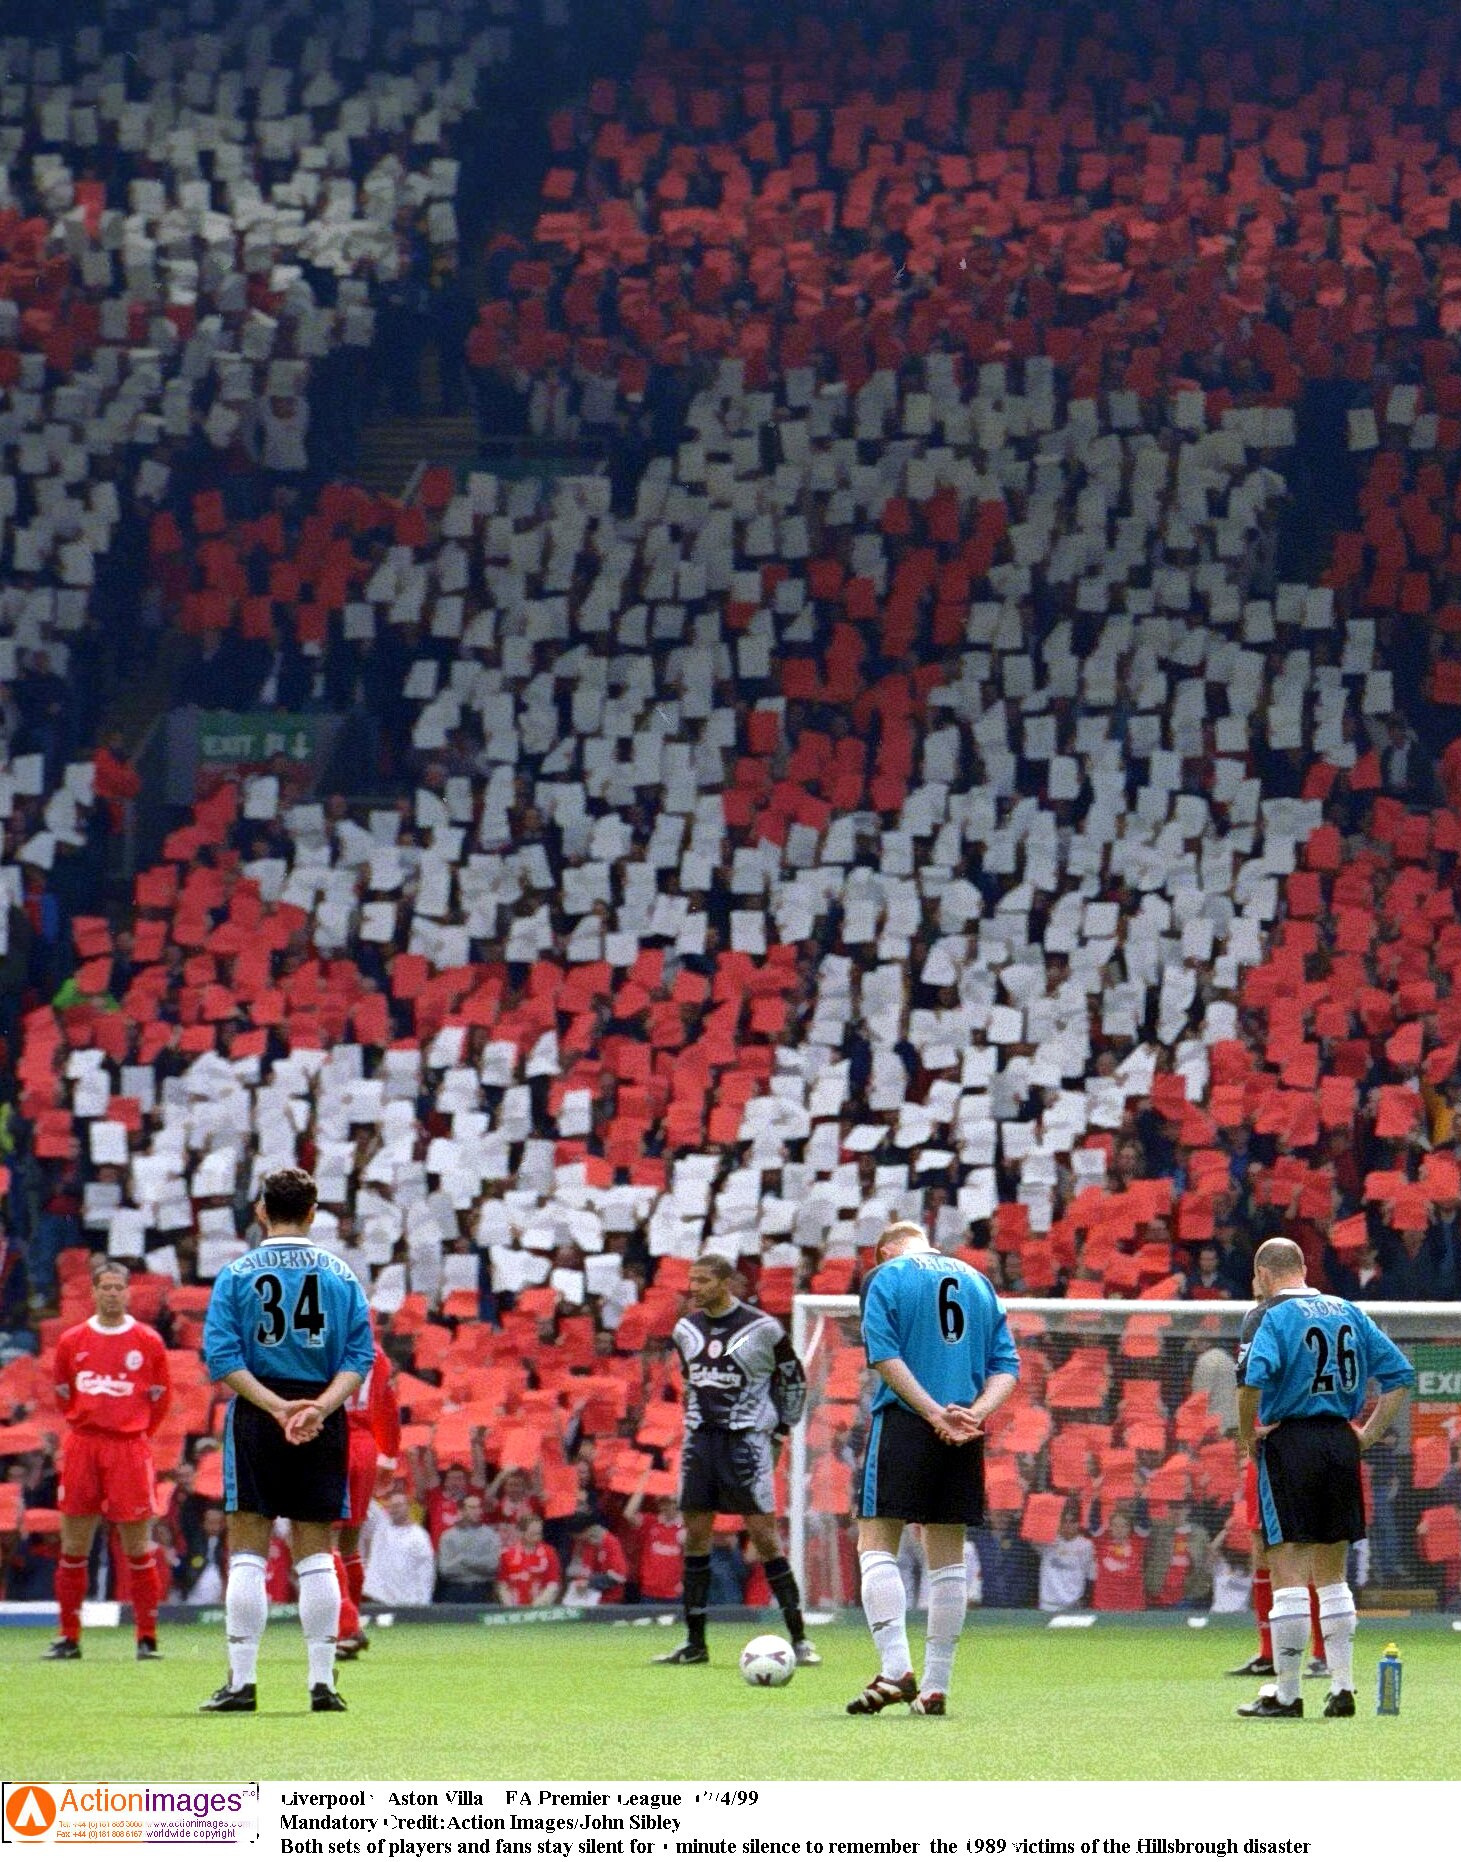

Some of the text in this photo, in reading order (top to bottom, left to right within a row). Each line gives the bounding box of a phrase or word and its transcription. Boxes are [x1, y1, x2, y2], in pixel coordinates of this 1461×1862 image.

[253, 1272, 328, 1346] 34
[937, 1275, 966, 1344] 6
[1304, 1324, 1359, 1395] 26
